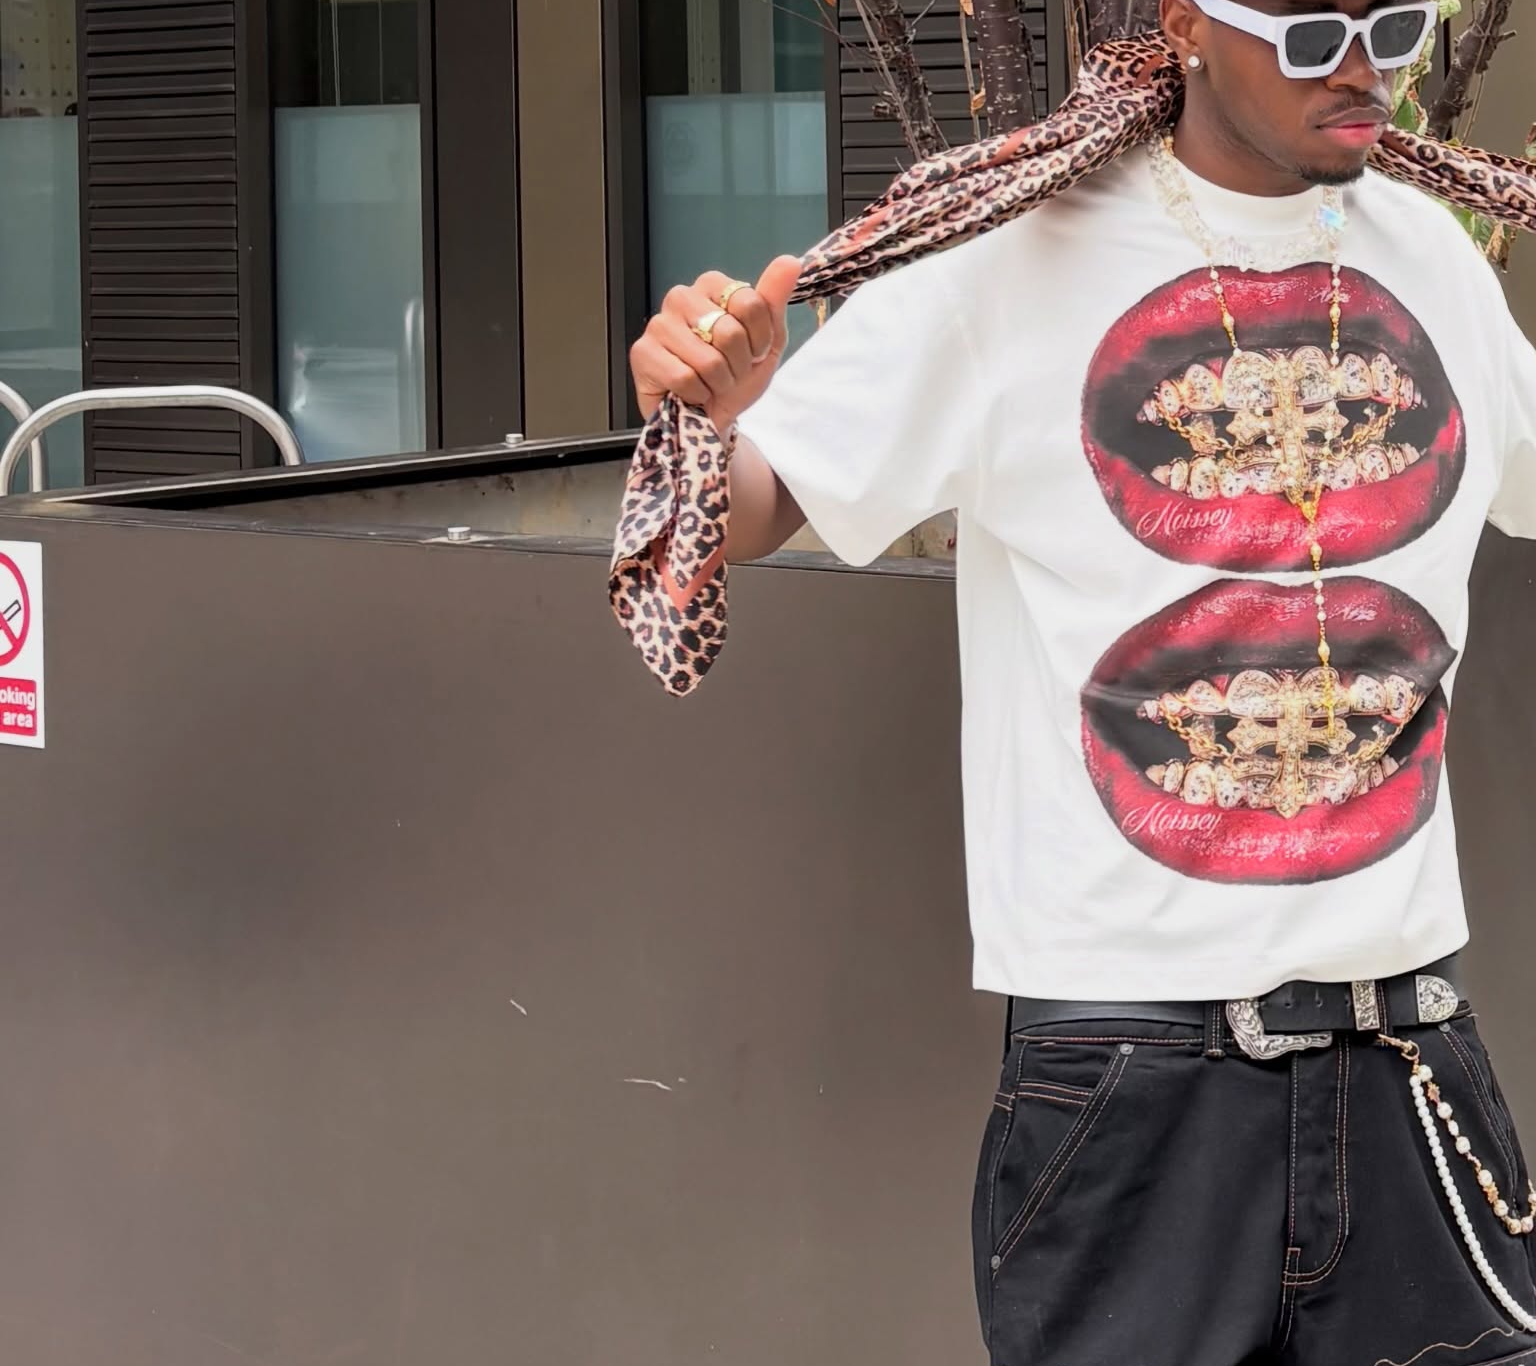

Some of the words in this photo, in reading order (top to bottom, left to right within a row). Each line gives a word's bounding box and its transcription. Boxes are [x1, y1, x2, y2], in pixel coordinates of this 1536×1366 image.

[1136, 500, 1233, 539] Noissey
[0, 686, 36, 711] oking
[3, 711, 33, 729] area
[1121, 801, 1223, 838] Noissey
